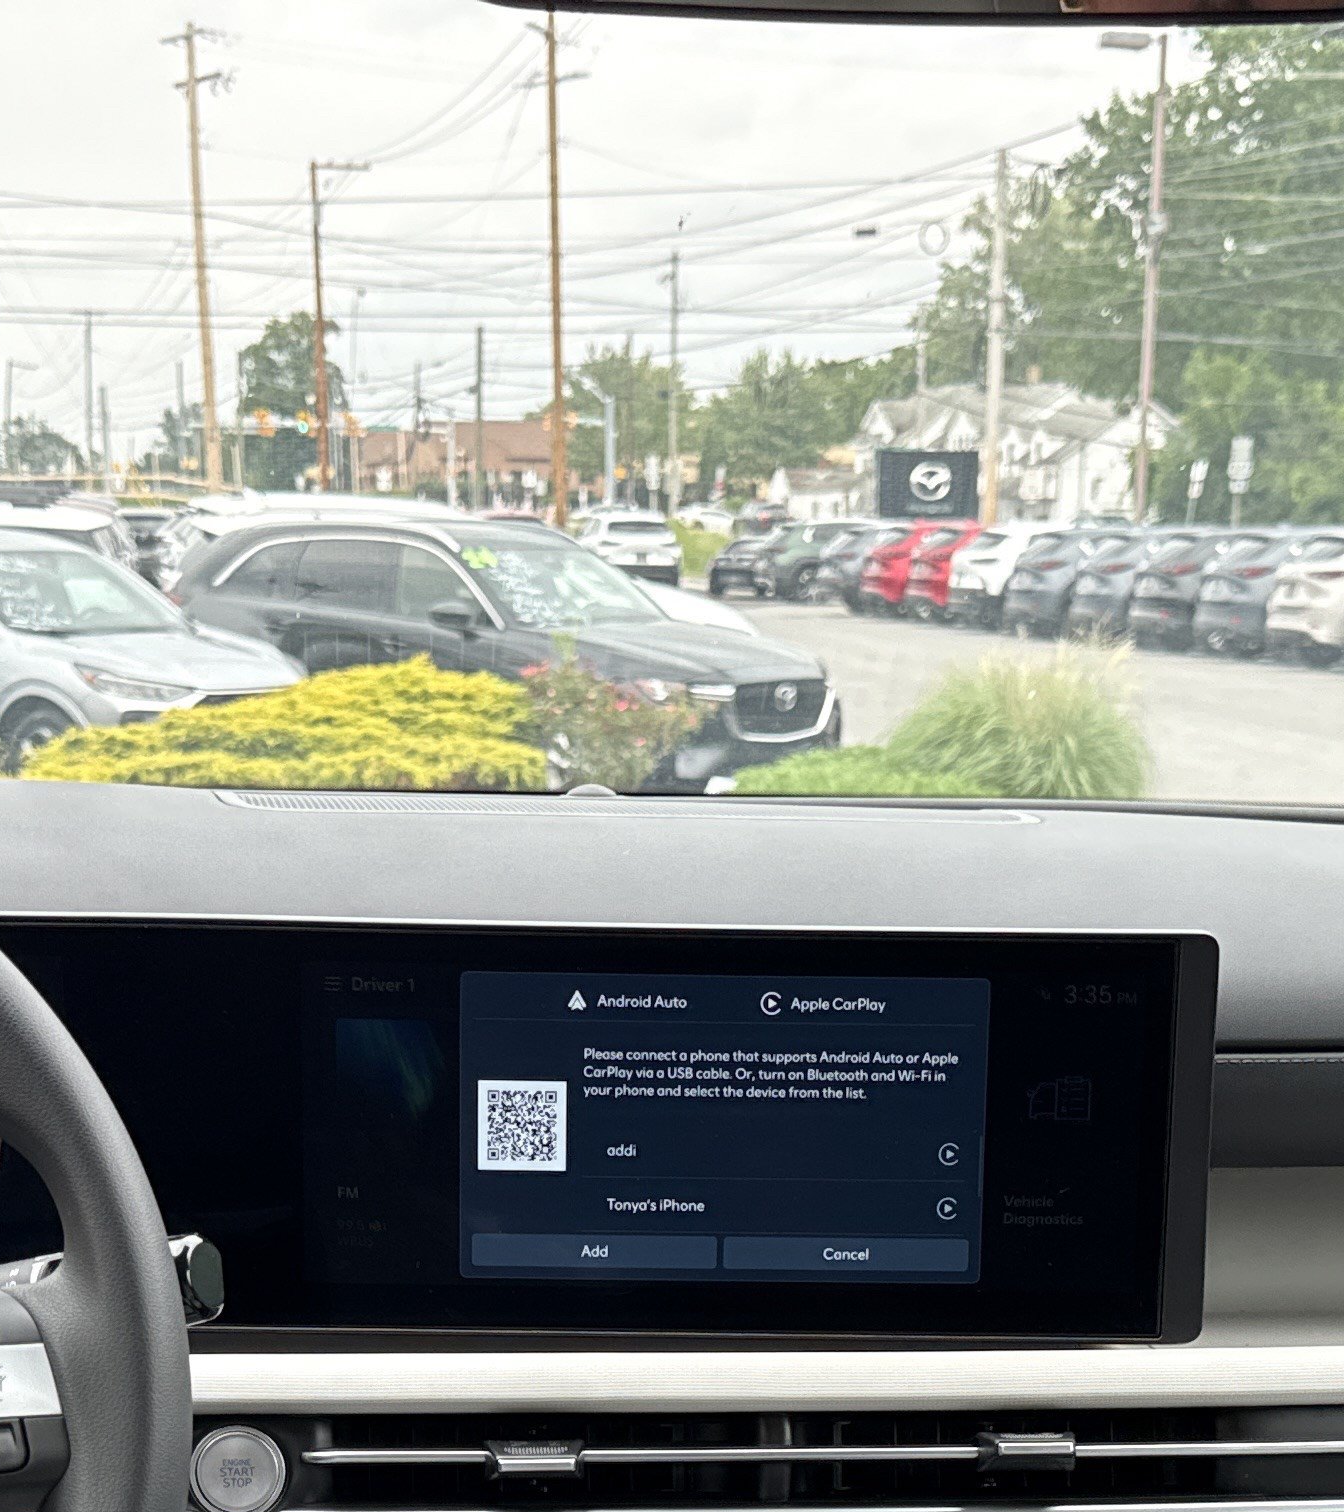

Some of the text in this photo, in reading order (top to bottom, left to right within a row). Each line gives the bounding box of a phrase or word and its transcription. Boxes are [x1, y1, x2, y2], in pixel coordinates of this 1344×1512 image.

[597, 994, 688, 1009] Android Auto
[1063, 984, 1112, 1006] 3:35
[790, 997, 886, 1014] Apple CarPlay
[583, 1047, 960, 1068] Please connect a phone that supports Android Auto or Apple
[583, 1065, 947, 1083] CarPlay via a USB cable. Or, turn on Bluetooth and Wi-Fi in
[583, 1084, 867, 1100] your phone and select the device from the list.
[606, 1143, 637, 1157] addi
[337, 1186, 359, 1200] FM
[606, 1197, 706, 1214] Tonya's iPhone
[1002, 1211, 1085, 1227] Diagnostics
[580, 1245, 609, 1259] Add
[822, 1247, 870, 1262] Cancel
[219, 1466, 255, 1478] START
[222, 1477, 253, 1489] STOP
